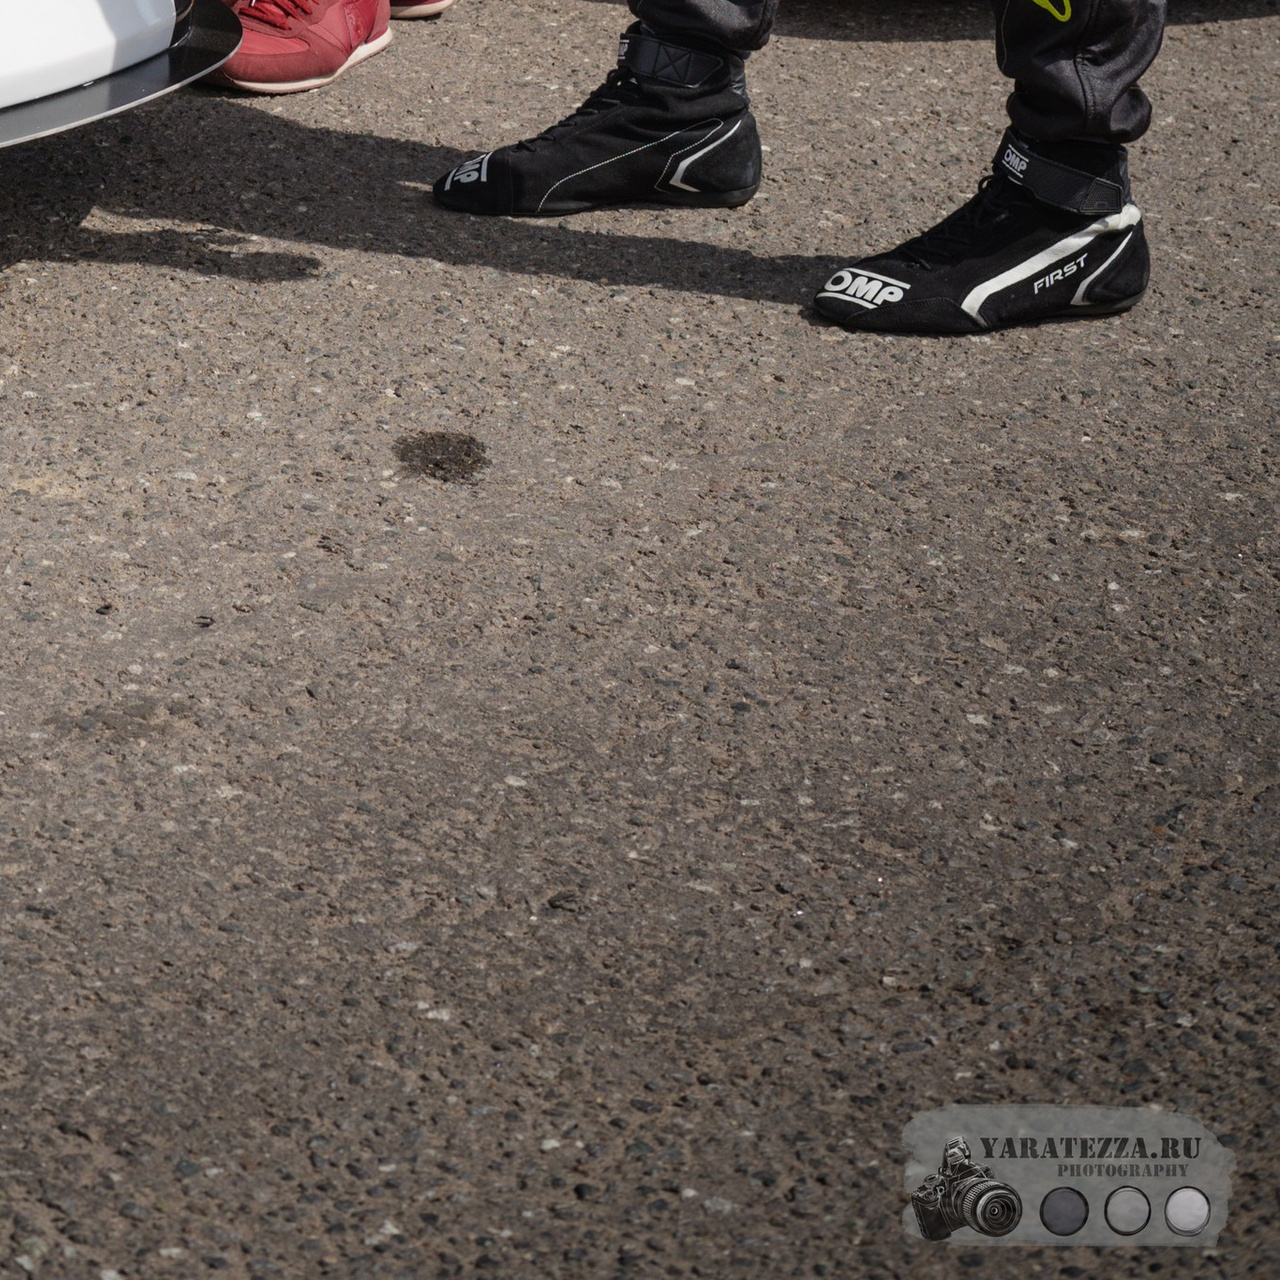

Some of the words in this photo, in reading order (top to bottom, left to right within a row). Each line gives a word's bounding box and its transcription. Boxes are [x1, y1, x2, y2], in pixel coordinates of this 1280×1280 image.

[1003, 148, 1028, 172] OMP
[823, 269, 904, 306] OMP
[1033, 252, 1088, 295] FIRST
